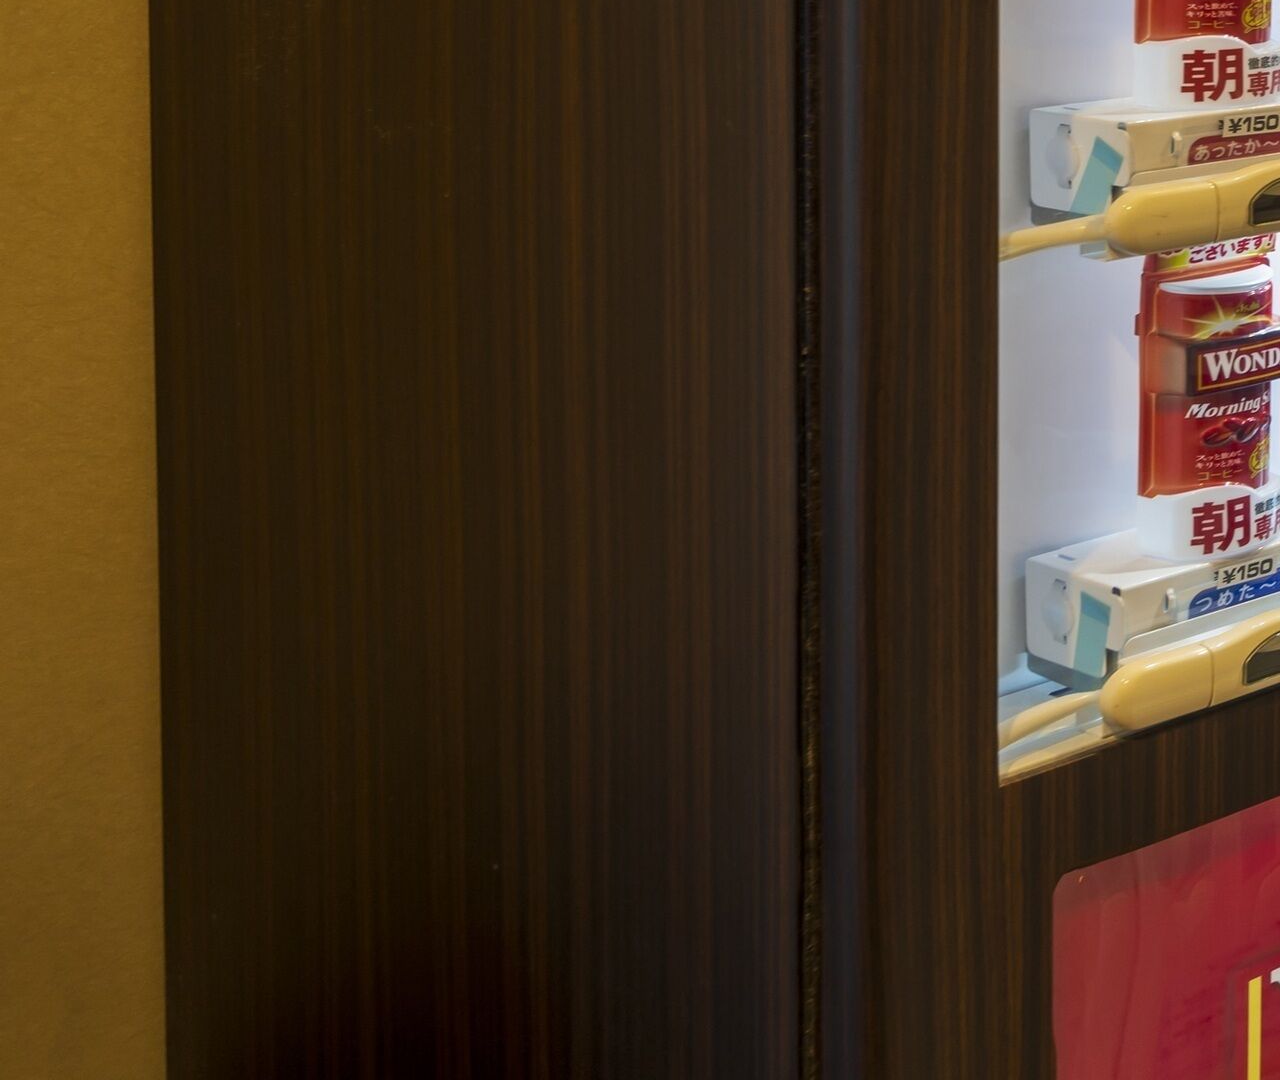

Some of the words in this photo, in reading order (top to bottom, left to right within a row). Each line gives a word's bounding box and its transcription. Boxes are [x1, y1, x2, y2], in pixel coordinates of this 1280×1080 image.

[1188, 20, 1235, 29] コーヒー
[1181, 47, 1244, 102] 朝
[1228, 114, 1279, 134] ¥150
[1184, 398, 1261, 420] Morning
[1198, 469, 1241, 481] コーヒー
[1190, 495, 1252, 555] 朝
[1223, 557, 1273, 584] ¥150
